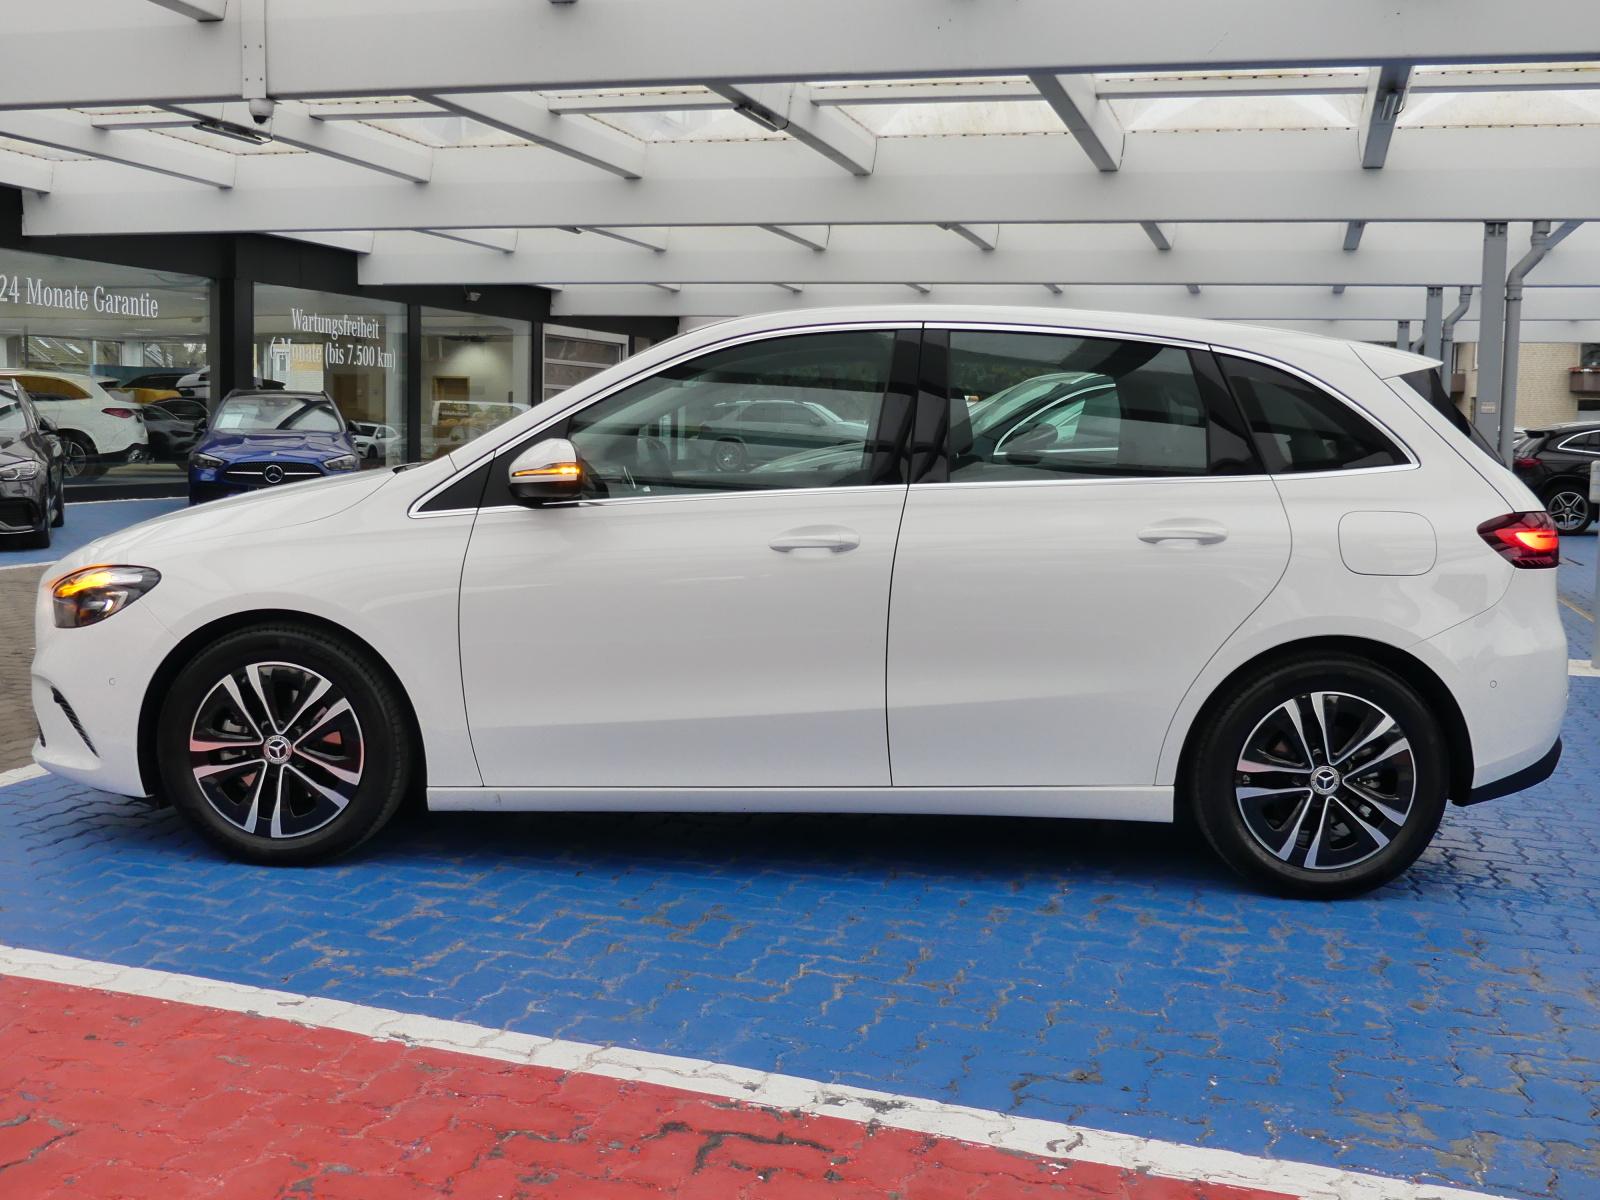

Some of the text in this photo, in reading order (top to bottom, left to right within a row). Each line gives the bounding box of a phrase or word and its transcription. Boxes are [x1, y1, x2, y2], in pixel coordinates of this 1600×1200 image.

[0, 274, 159, 318] 24 Monate Garantie
[291, 308, 380, 340] Wartungsfreiheit
[280, 337, 322, 363] Monate
[325, 342, 345, 369] (bis
[347, 344, 375, 367] 7.500
[378, 347, 396, 373] km)
